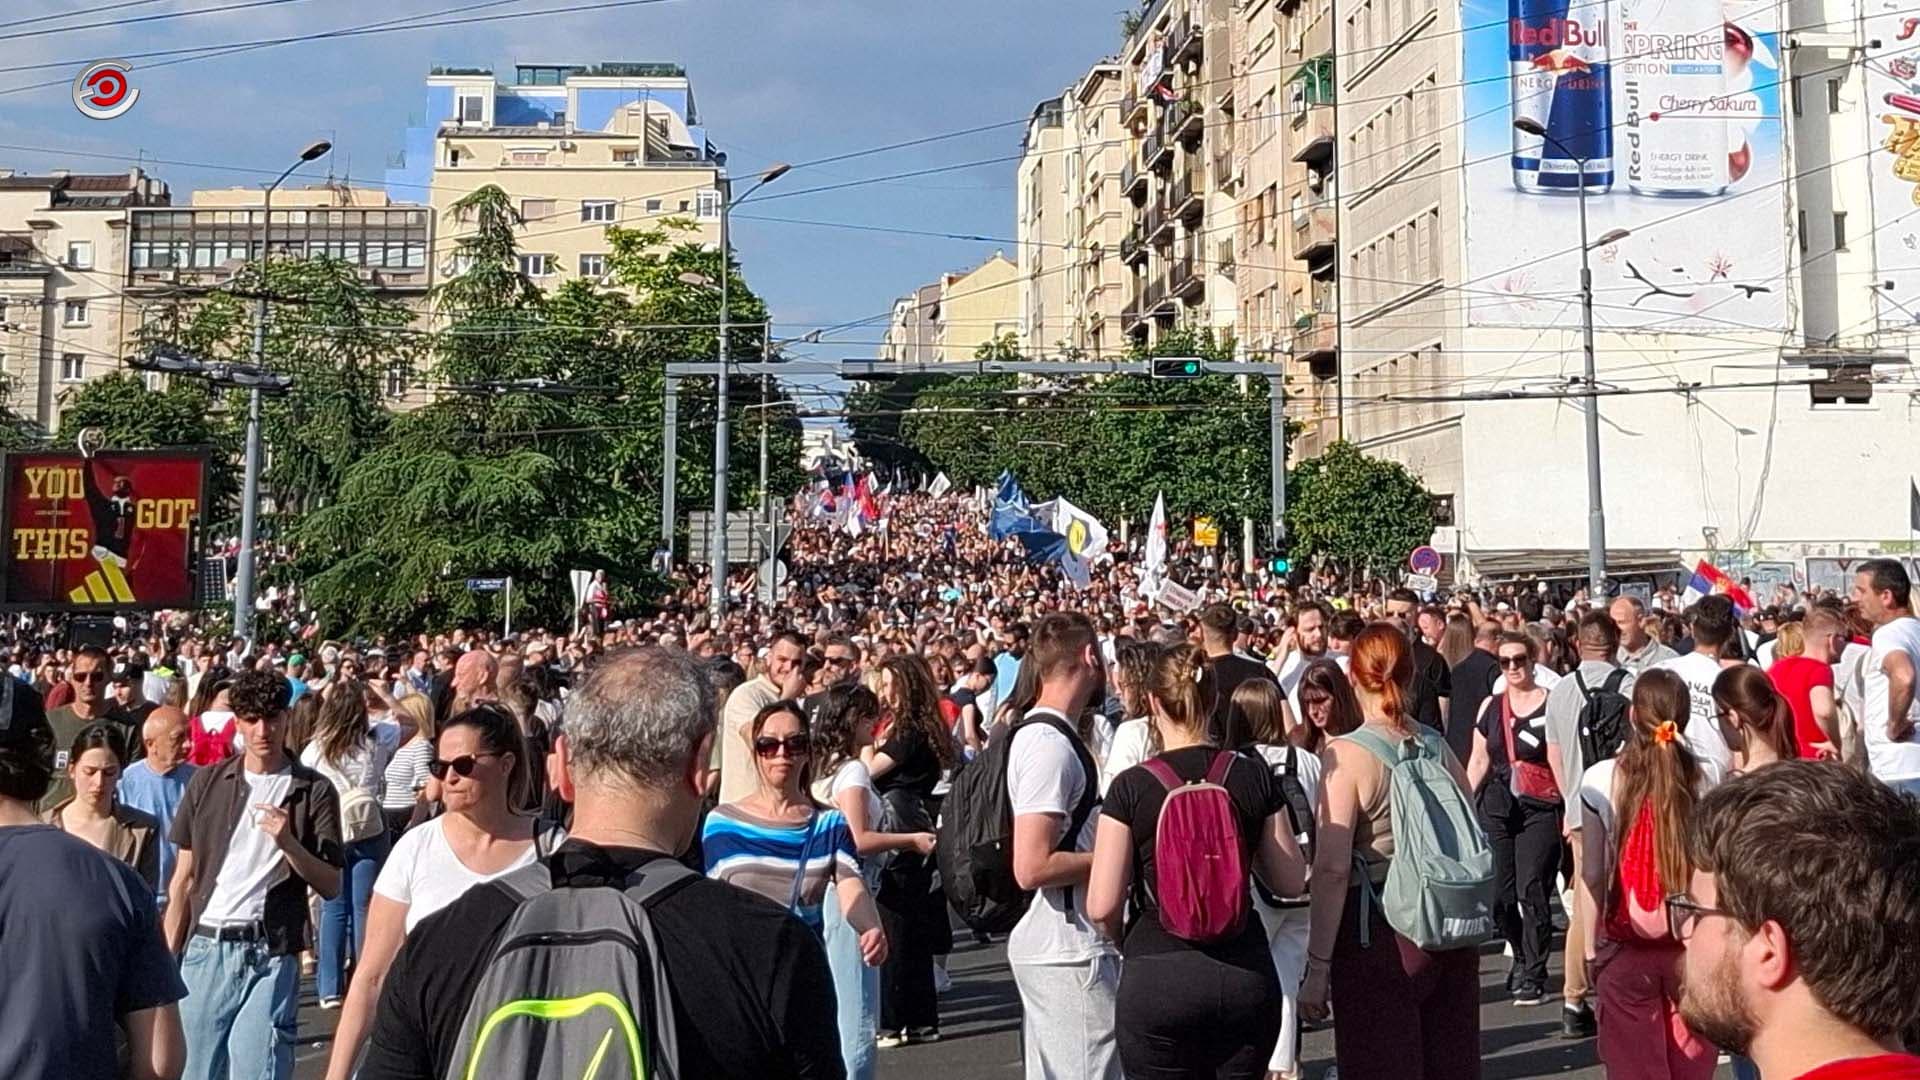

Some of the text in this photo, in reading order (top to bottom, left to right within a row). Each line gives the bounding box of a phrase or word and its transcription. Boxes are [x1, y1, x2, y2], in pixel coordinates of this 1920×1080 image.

[1512, 18, 1606, 48] Red Bull
[1624, 34, 1723, 60] SPRING
[1659, 94, 1757, 114] Cherry Sakura
[1625, 81, 1642, 181] Red Bull
[25, 467, 86, 499] YOU
[136, 498, 196, 529] GOT
[13, 528, 89, 560] THIS
